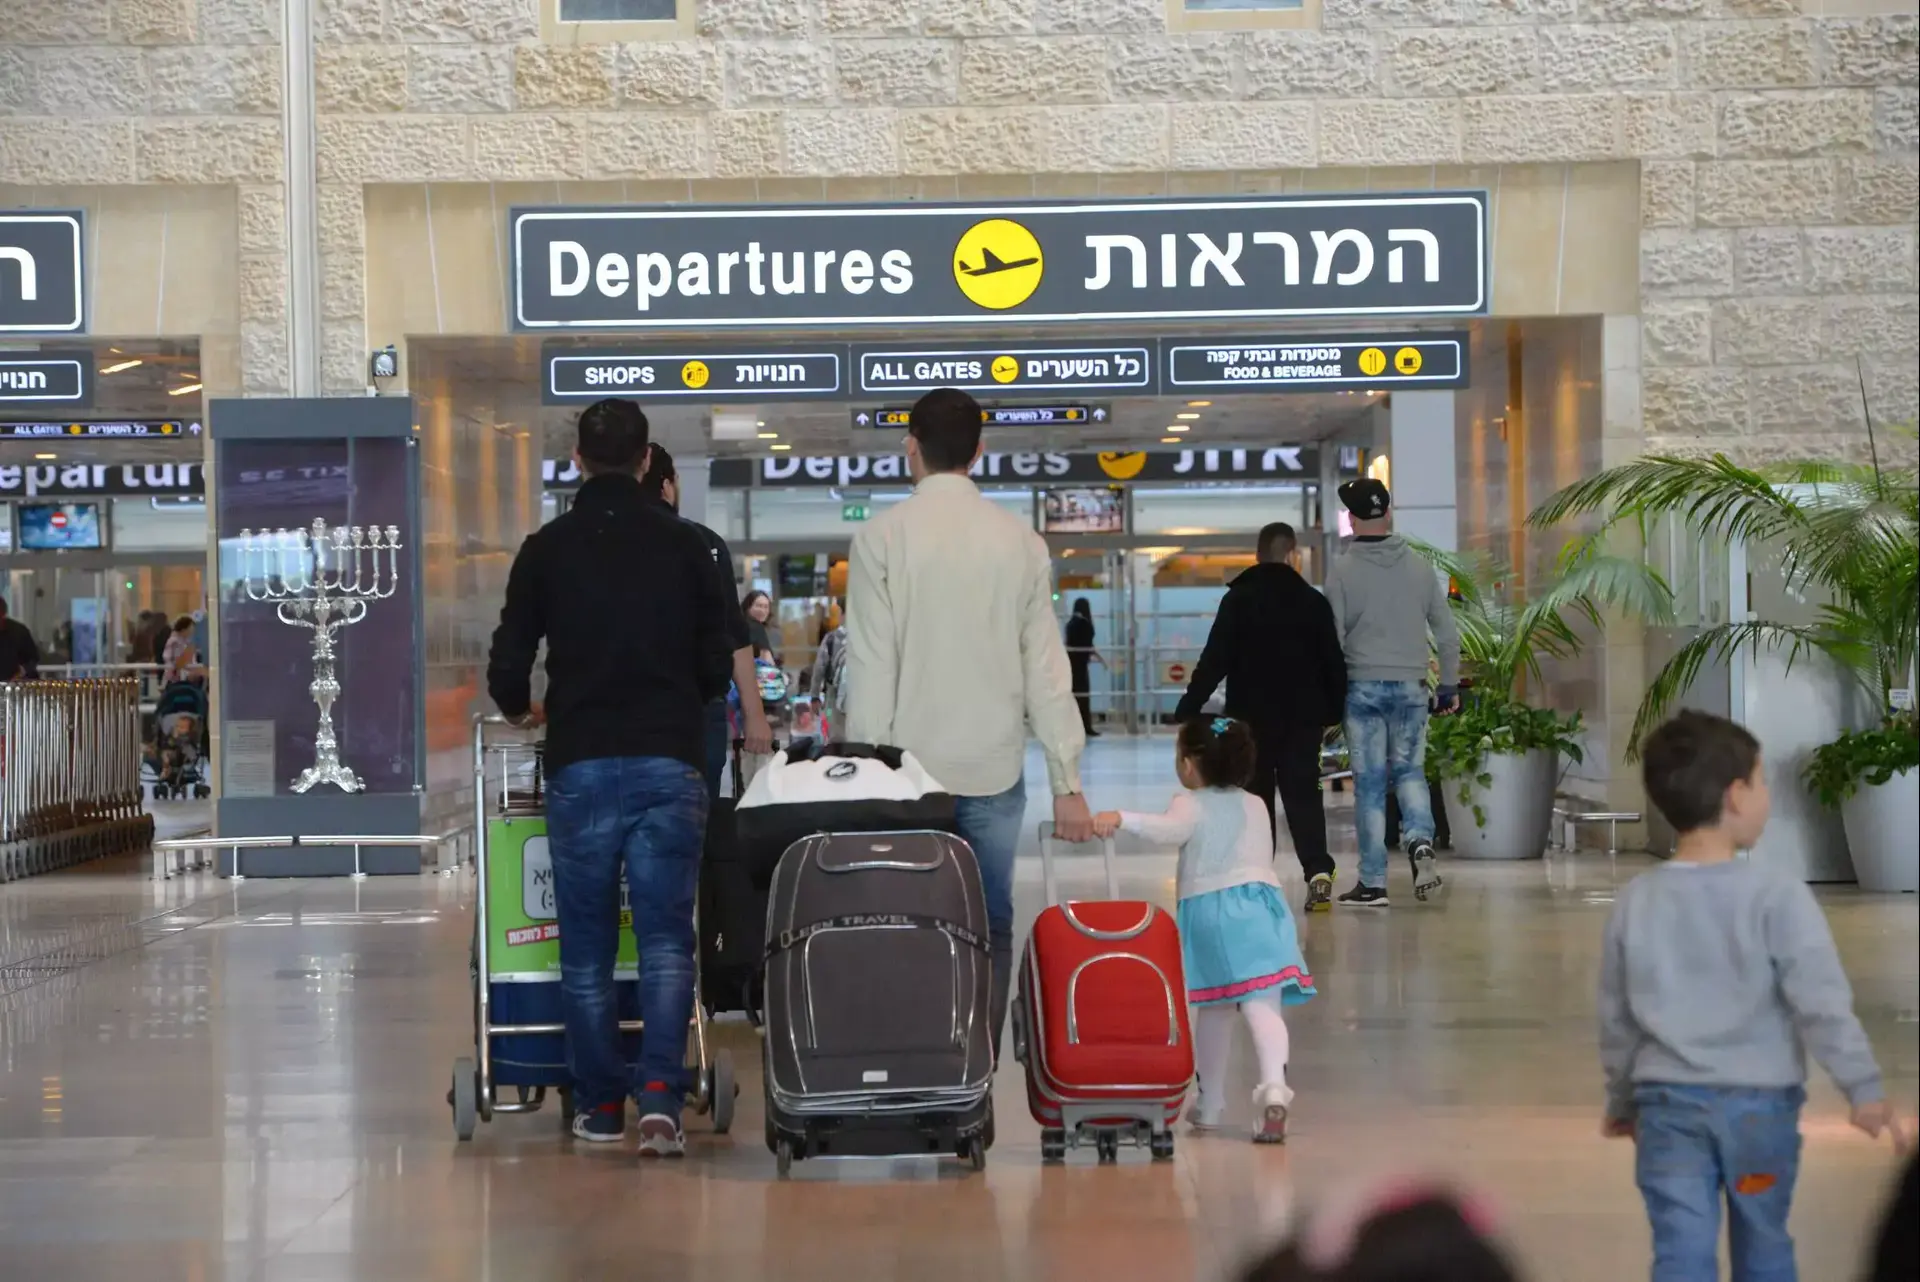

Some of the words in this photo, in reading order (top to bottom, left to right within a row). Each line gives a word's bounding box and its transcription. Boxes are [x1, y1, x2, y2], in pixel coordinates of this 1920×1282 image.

[1084, 228, 1440, 290] המראות
[548, 240, 914, 311] Departures
[1206, 350, 1240, 365] קפה
[1244, 349, 1276, 362] ובתי
[1280, 348, 1341, 362] מסעדות
[736, 364, 806, 382] חנויות
[870, 362, 910, 380] ALL
[914, 361, 982, 380] GATES
[1027, 359, 1109, 379] השערים
[1114, 354, 1140, 376] כל
[1223, 366, 1260, 379] FOOD
[1261, 366, 1271, 378] &
[1273, 364, 1342, 378] BEVERAGE
[585, 366, 655, 385] SHOPS
[14, 425, 32, 435] ALL
[32, 425, 63, 435] GATES
[0, 463, 205, 497] epartur
[841, 914, 915, 925] TRAVEL
